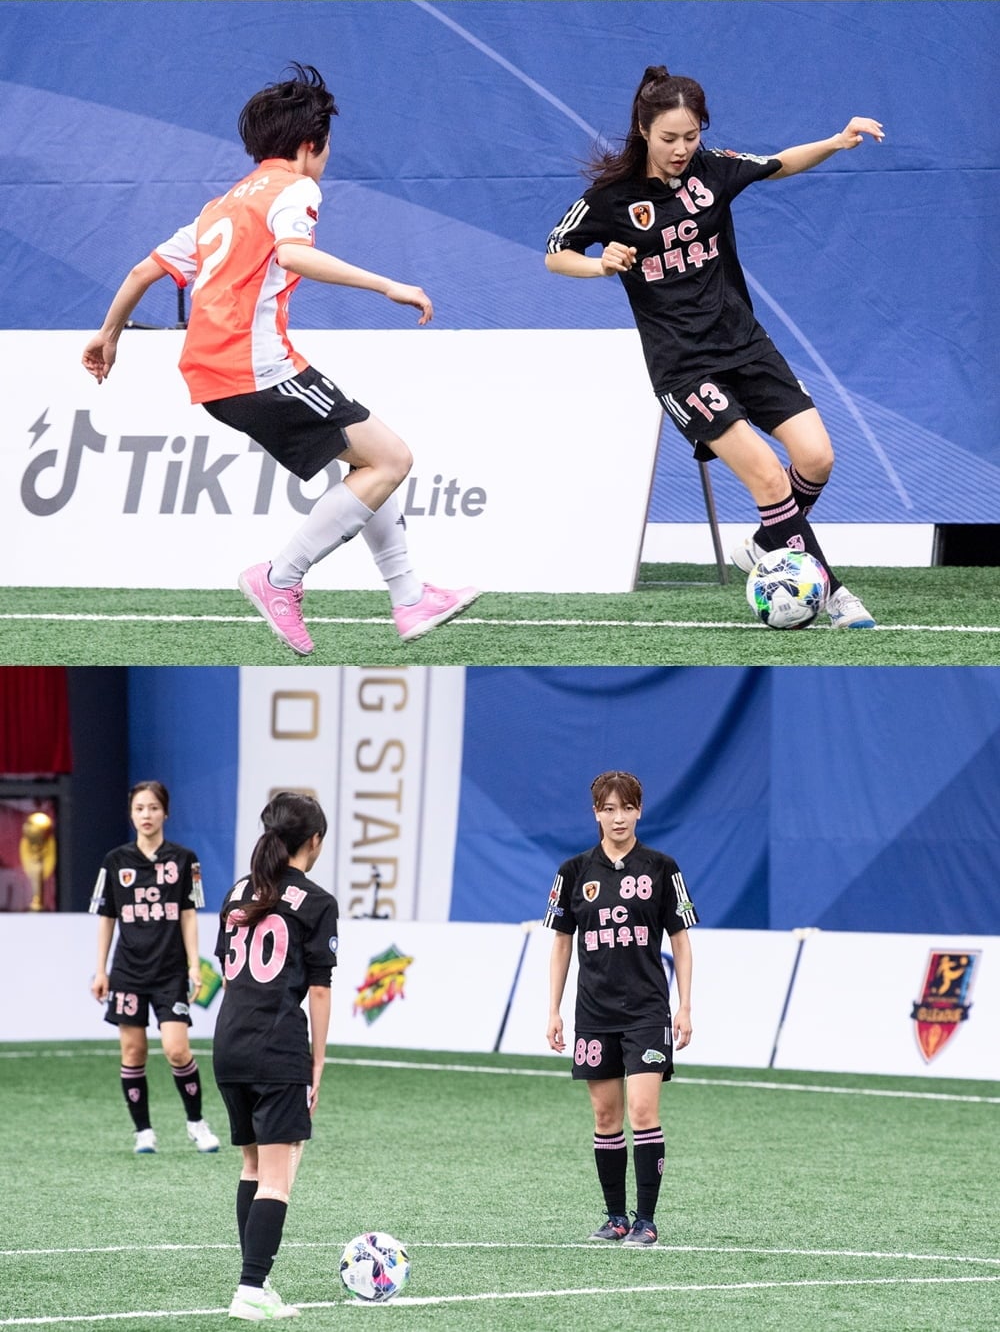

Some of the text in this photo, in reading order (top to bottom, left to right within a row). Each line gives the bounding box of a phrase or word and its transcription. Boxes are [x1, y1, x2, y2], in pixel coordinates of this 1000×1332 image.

[675, 176, 715, 215] 13
[661, 219, 699, 249] FC
[191, 216, 233, 297] 2
[686, 382, 729, 422] 13
[118, 435, 487, 517] TikTo Lite
[154, 861, 179, 885] 13
[619, 874, 653, 900] 88
[134, 886, 161, 903] FC
[598, 905, 629, 926] FC
[225, 908, 289, 984] 30
[584, 925, 648, 951] 원더우먼
[115, 992, 139, 1016] 13
[574, 1037, 603, 1068] 88
